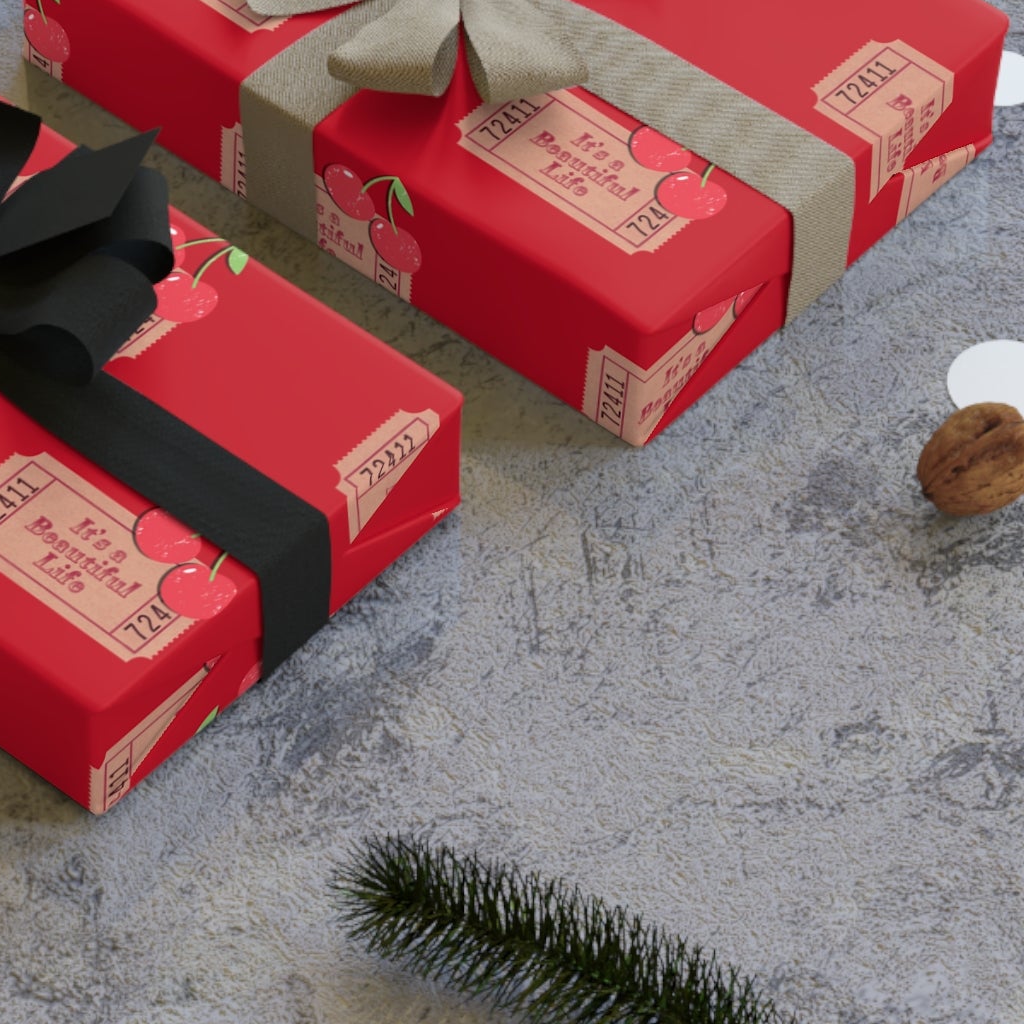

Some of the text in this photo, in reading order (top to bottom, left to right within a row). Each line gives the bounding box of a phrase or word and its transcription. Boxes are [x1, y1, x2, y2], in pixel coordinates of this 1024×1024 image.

[835, 60, 897, 104] 72411
[479, 98, 541, 141] 72411
[529, 130, 641, 202] Beautiful
[570, 132, 625, 172] It's a
[886, 127, 903, 173] Life
[539, 160, 588, 197] Life
[626, 206, 670, 237] 724
[601, 373, 625, 426] 72411
[25, 515, 143, 599] Beautiful
[69, 517, 127, 564] It's a
[32, 551, 86, 594] Life
[123, 604, 172, 640] 724
